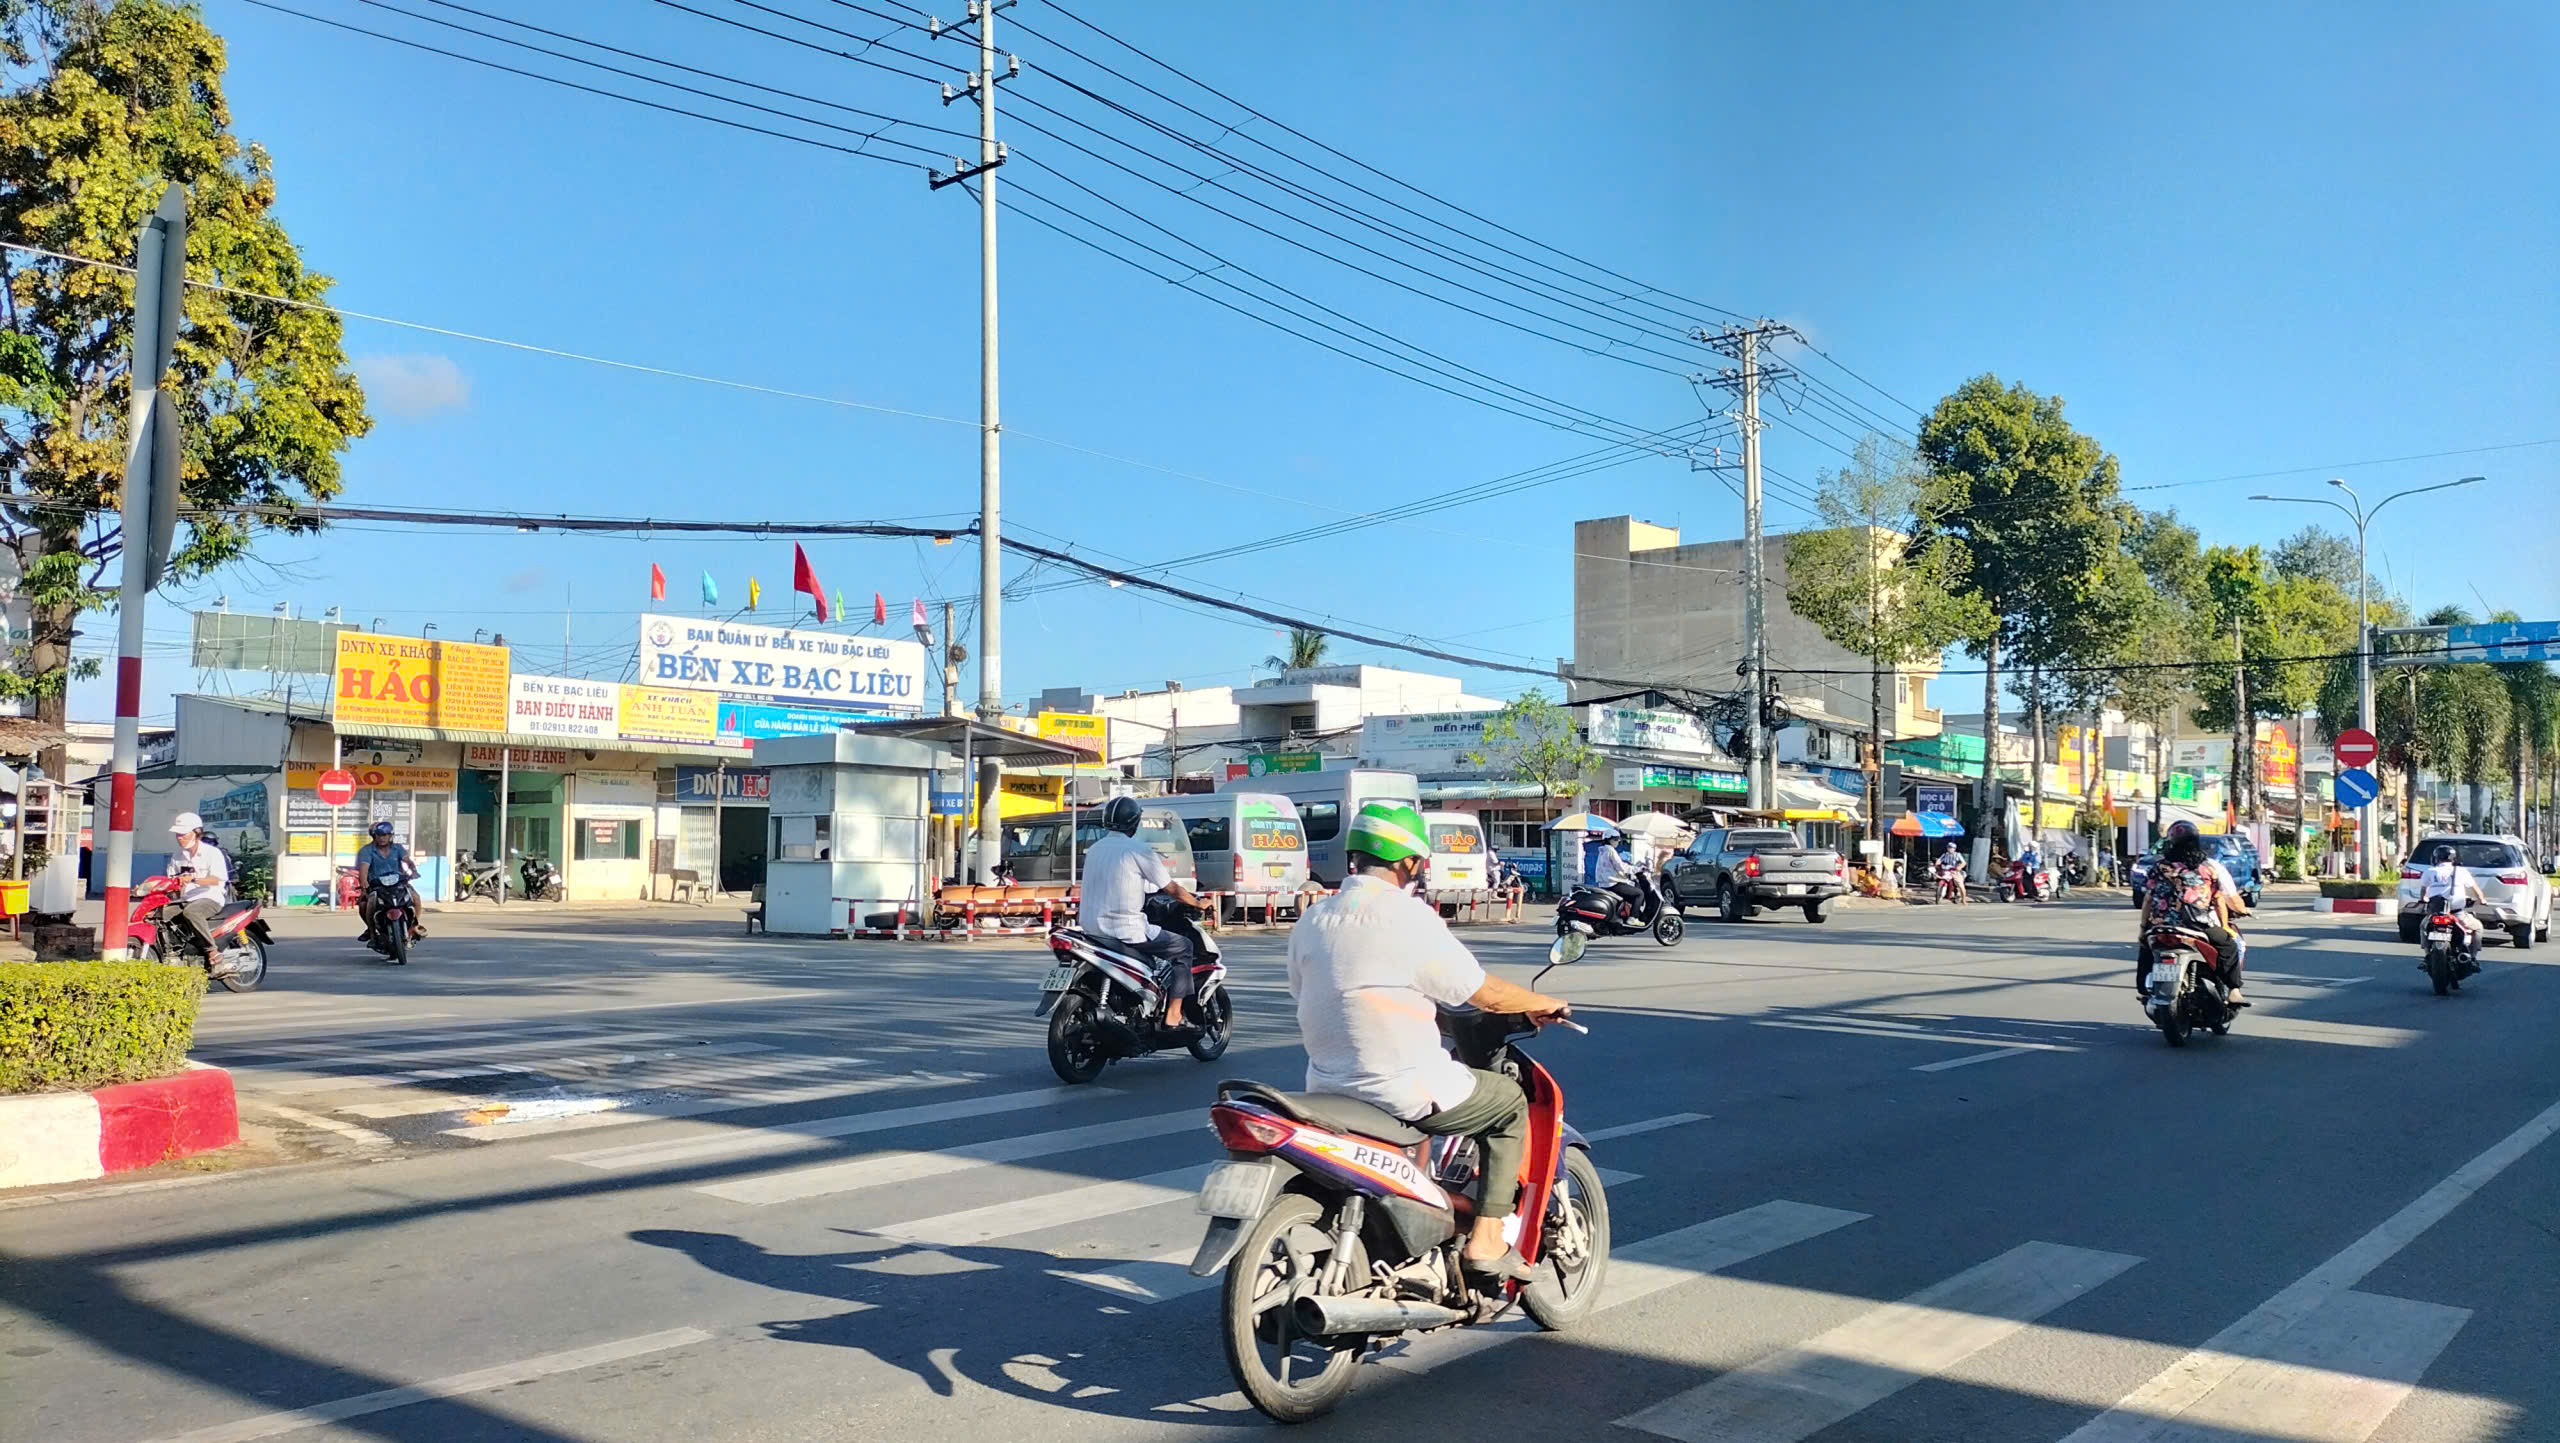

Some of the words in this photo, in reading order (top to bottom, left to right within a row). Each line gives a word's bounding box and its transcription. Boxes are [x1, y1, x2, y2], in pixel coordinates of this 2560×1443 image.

[341, 639, 375, 654] DNTN
[380, 643, 396, 656] XE
[400, 643, 442, 660] KHÁCH
[687, 628, 713, 642] BAN
[718, 629, 751, 647] QUẢN
[755, 633, 768, 648] LÝ
[772, 634, 794, 650] BẾN
[799, 640, 813, 652] XE
[817, 640, 838, 655] TÀU
[842, 645, 863, 659] BẠC
[867, 645, 889, 659] LIÊU
[656, 644, 722, 682] BẾN
[731, 661, 775, 687] XE
[782, 665, 841, 695] BẠC
[849, 668, 912, 697] LIÊU
[339, 658, 440, 705] HẢO
[523, 679, 544, 693] BẾN
[547, 684, 560, 694] XE
[563, 686, 583, 697] BẠC
[587, 687, 608, 699] LIÊU
[515, 700, 542, 716] BAN
[578, 702, 613, 721] HÀNH
[632, 703, 662, 713] ANH
[771, 719, 792, 731] HÀNG
[793, 722, 808, 732] BÁN
[471, 747, 497, 761] BAN
[532, 748, 566, 765] HÀNH
[291, 760, 316, 771] DNTN
[947, 799, 956, 808] XE
[957, 799, 974, 808] BT
[1920, 793, 1938, 803] HỌC
[1940, 792, 1954, 802] LÁI
[1251, 830, 1299, 849] HẢO
[1441, 832, 1476, 847] HẢO
